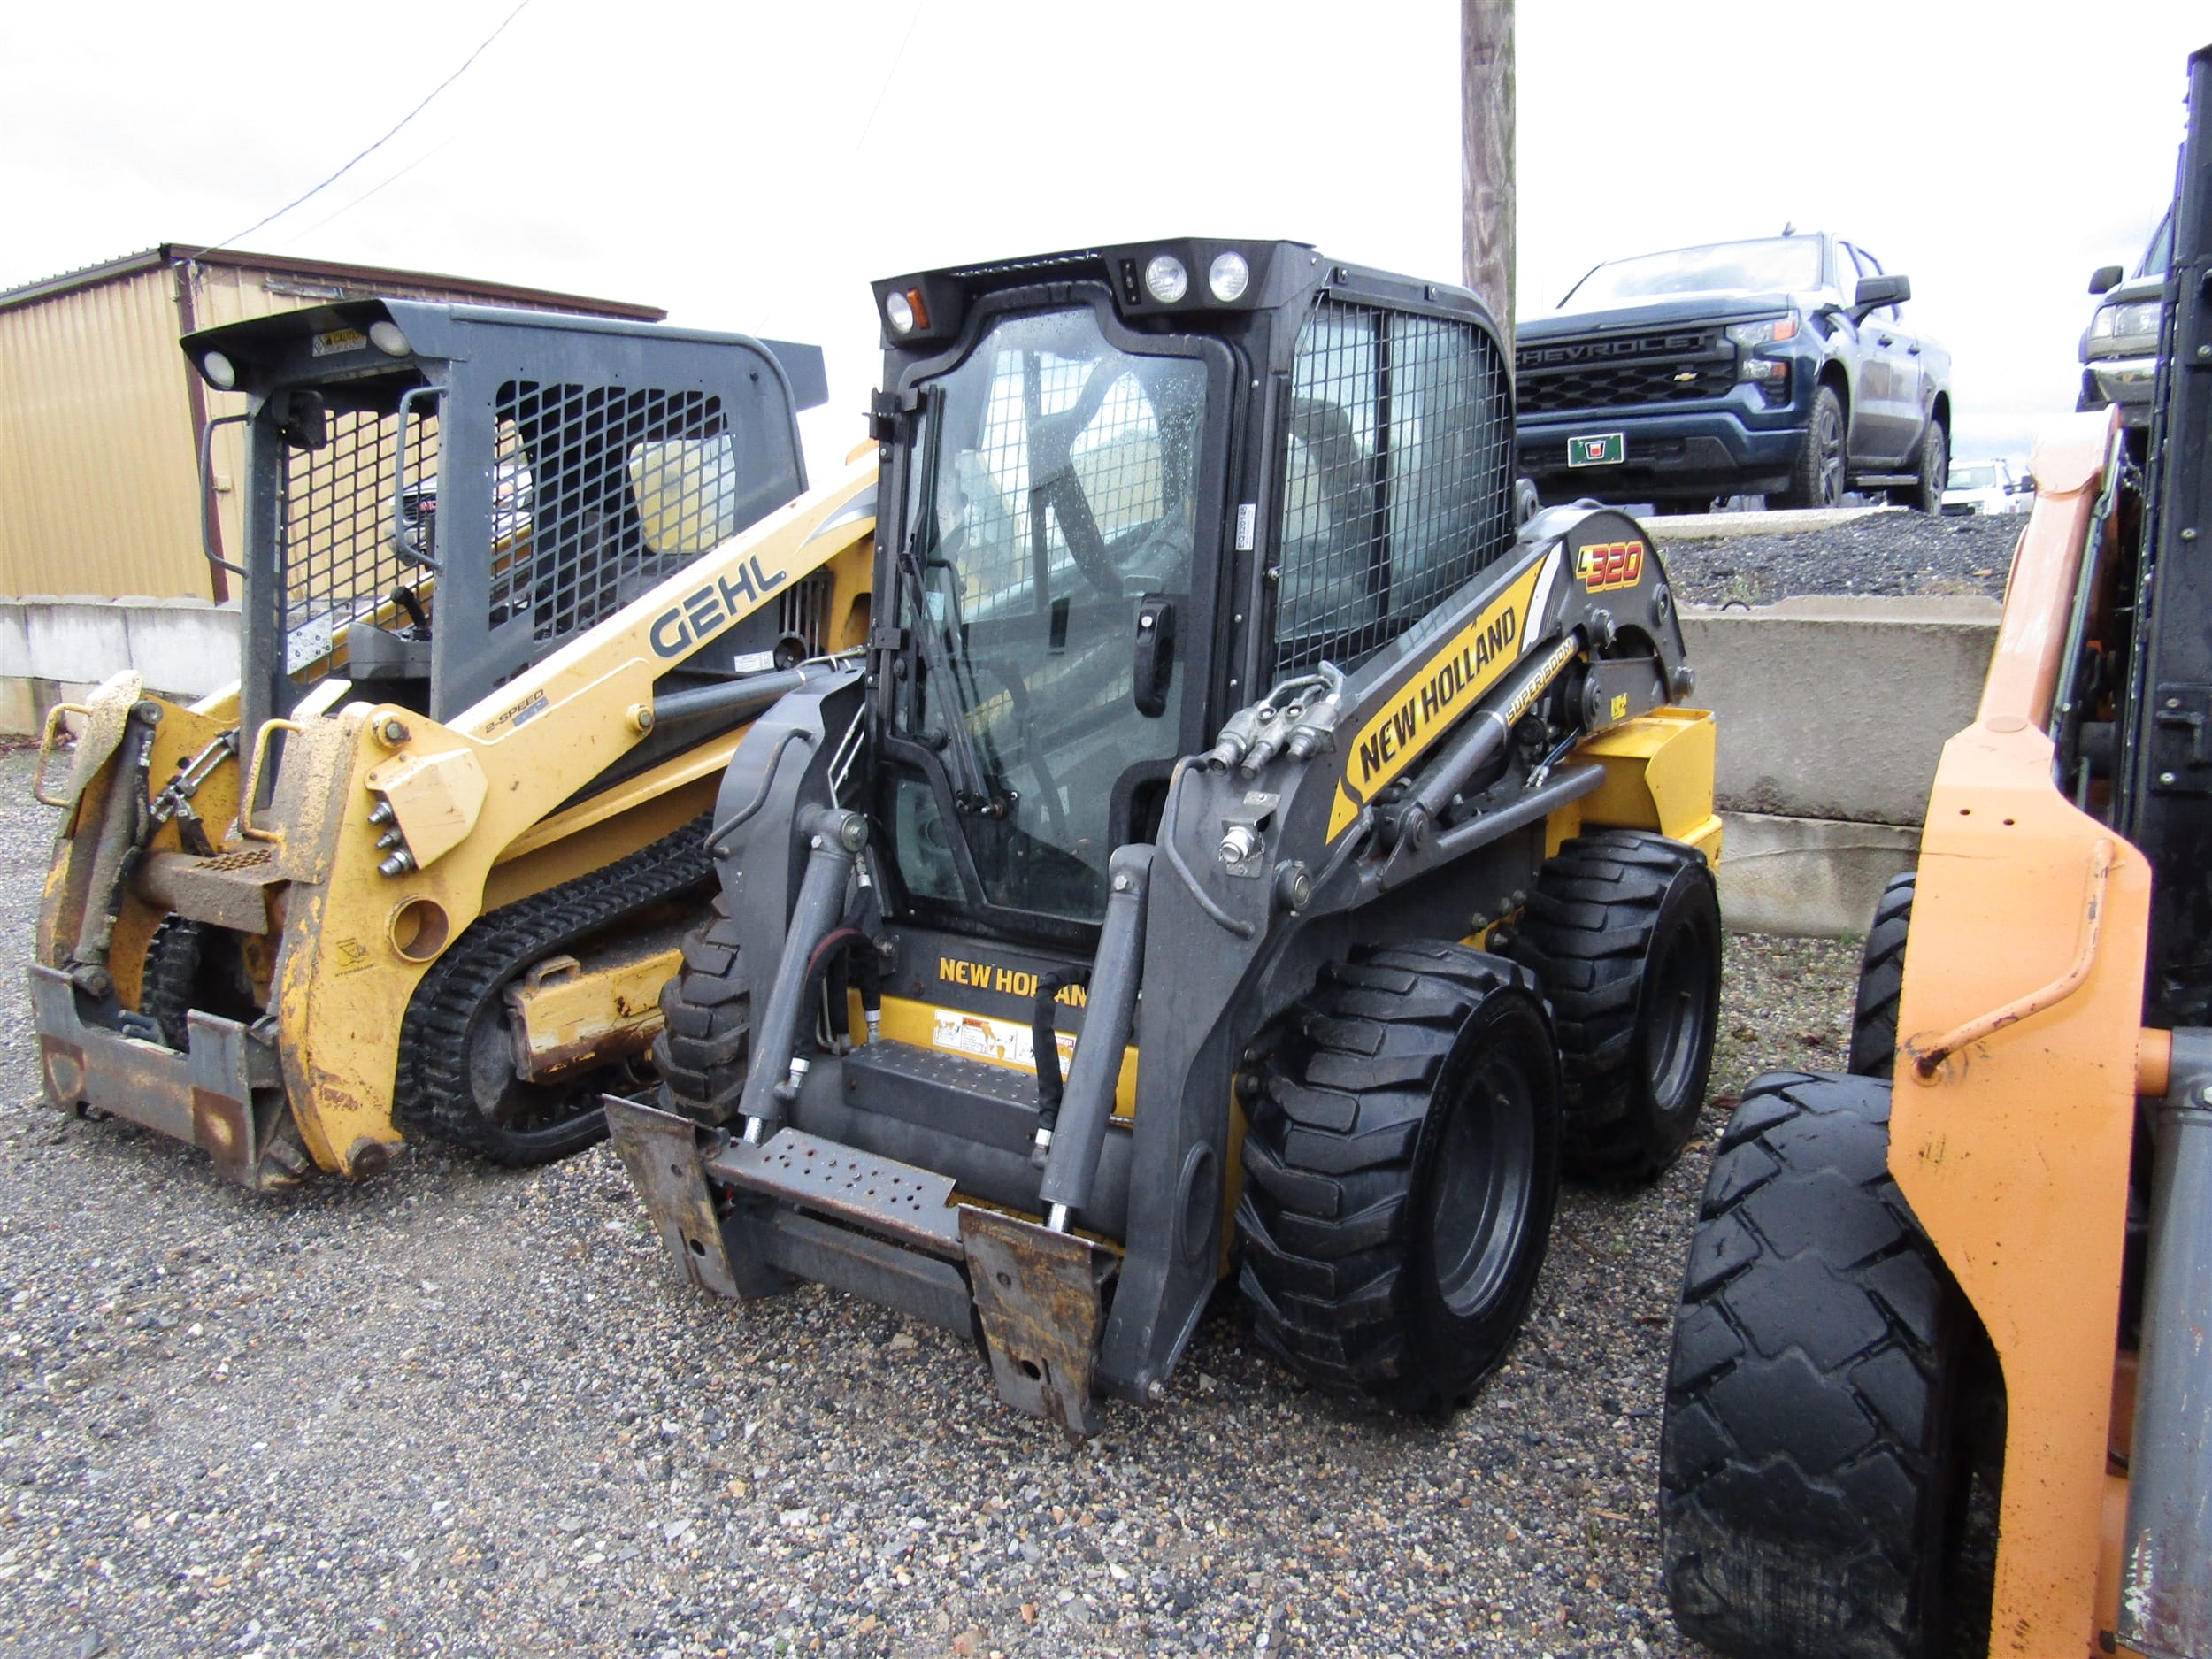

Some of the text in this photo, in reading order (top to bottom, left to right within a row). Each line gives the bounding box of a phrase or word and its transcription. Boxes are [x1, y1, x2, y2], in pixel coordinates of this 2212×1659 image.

[1577, 542, 1643, 591] L320
[650, 555, 787, 658] GEHL
[486, 688, 544, 734] 2-SPEED
[1359, 606, 1516, 784] NEW HOLLAND
[939, 957, 1087, 1009] NEW HOLAN
